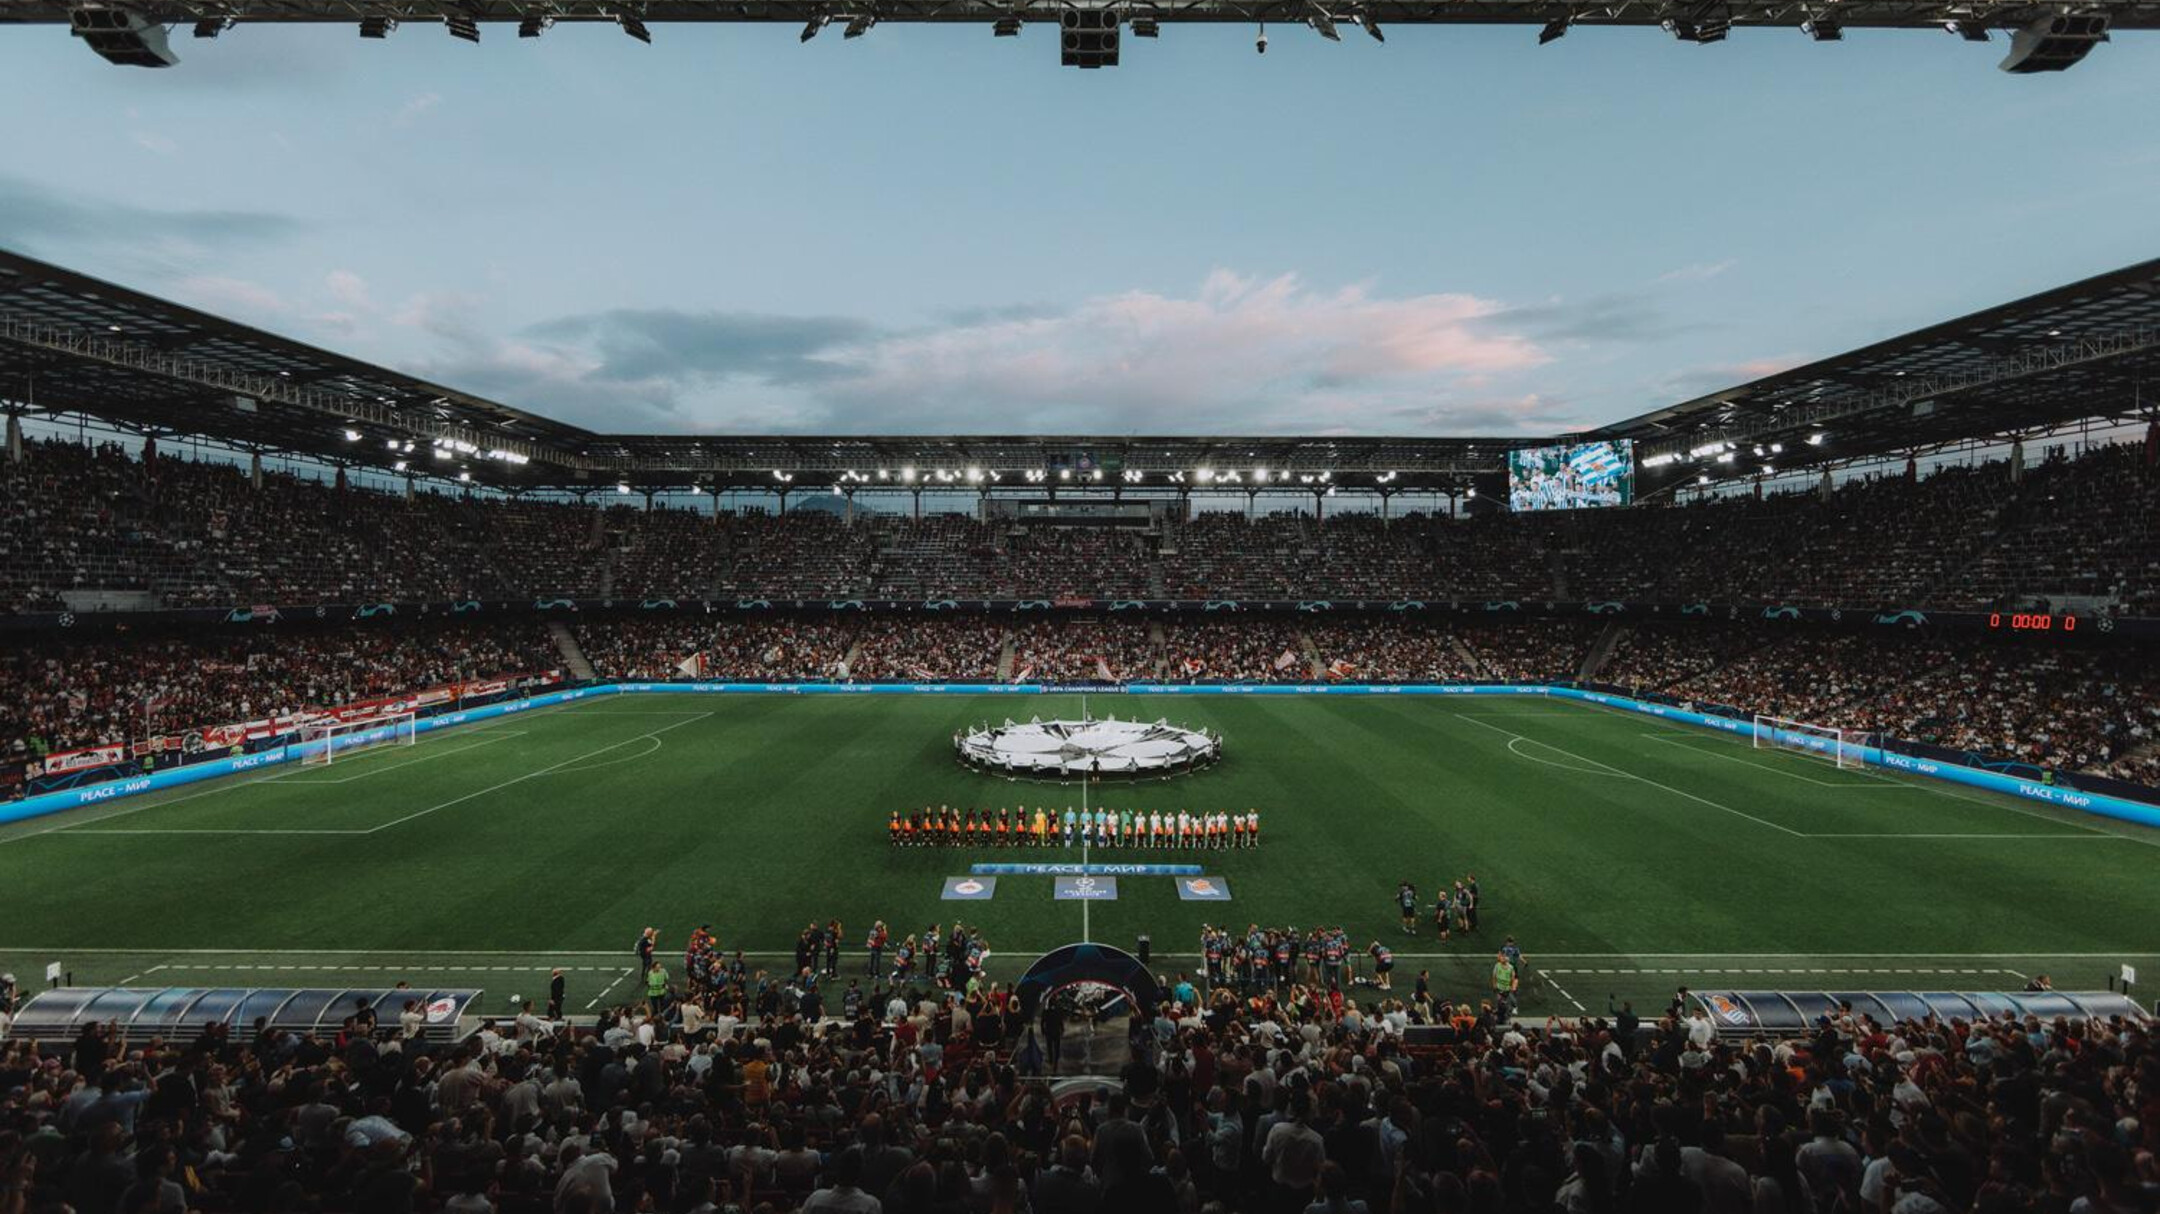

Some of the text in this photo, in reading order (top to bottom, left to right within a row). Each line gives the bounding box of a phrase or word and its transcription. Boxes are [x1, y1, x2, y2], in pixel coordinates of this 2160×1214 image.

[1990, 613, 2076, 630] 0 00:00 0
[1886, 756, 1910, 768] PEACE
[80, 786, 115, 802] PEACE
[125, 779, 151, 793] МИР
[2020, 784, 2053, 800] PEACE
[2063, 793, 2091, 807] МИР
[1026, 864, 1084, 873] PEACE
[1104, 864, 1147, 873] МИР
